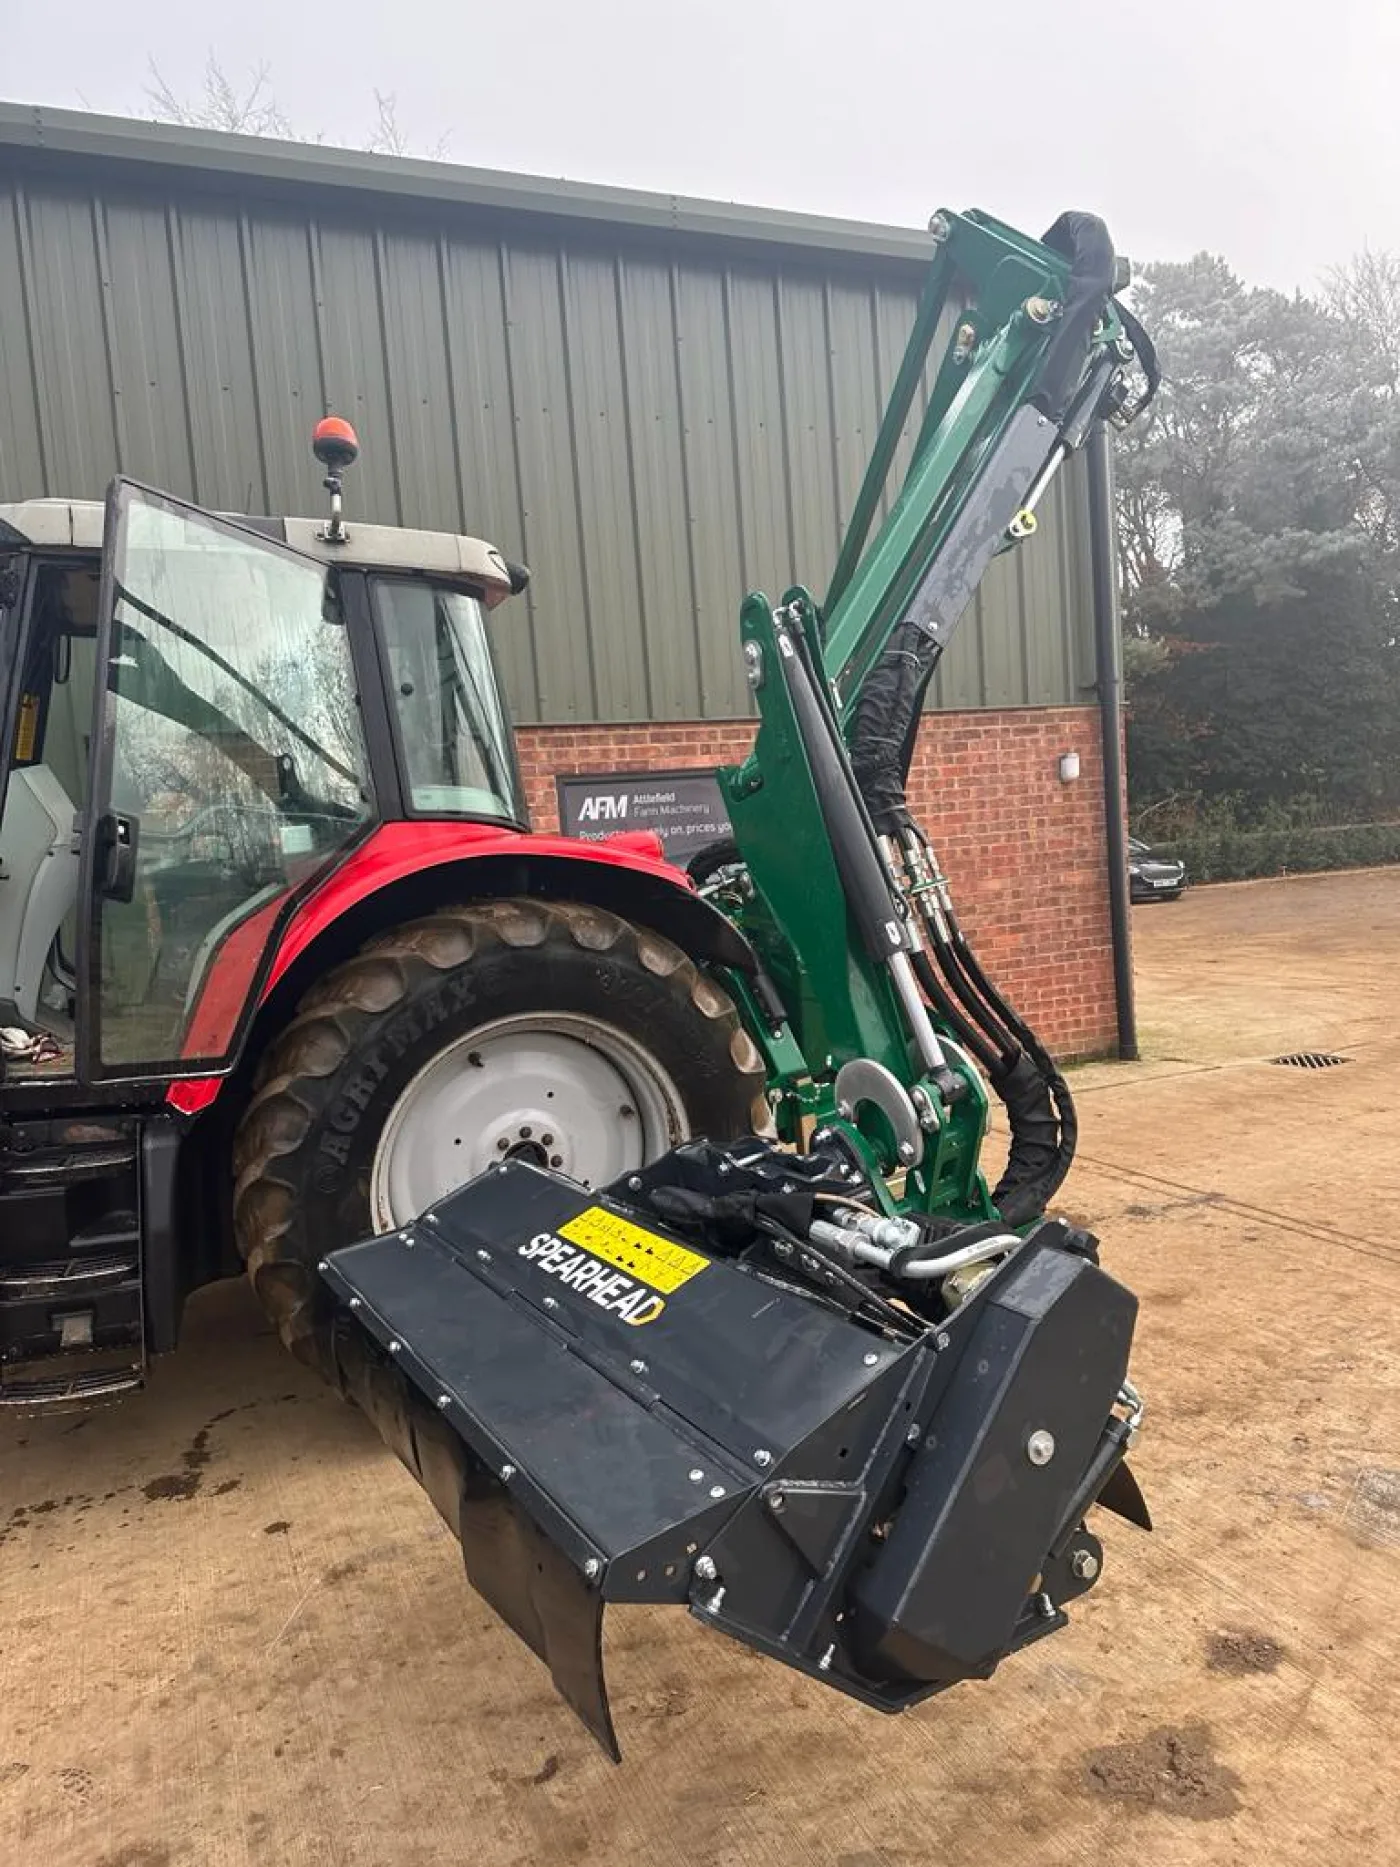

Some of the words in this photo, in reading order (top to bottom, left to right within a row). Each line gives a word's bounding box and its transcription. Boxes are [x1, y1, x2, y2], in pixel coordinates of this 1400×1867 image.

[578, 795, 628, 821] AFM
[634, 806, 658, 816] Farm
[660, 804, 710, 815] Machinery
[687, 823, 716, 836] prices
[320, 971, 478, 1166] AGRIMAX
[517, 1232, 667, 1326] SPEARHEAD
